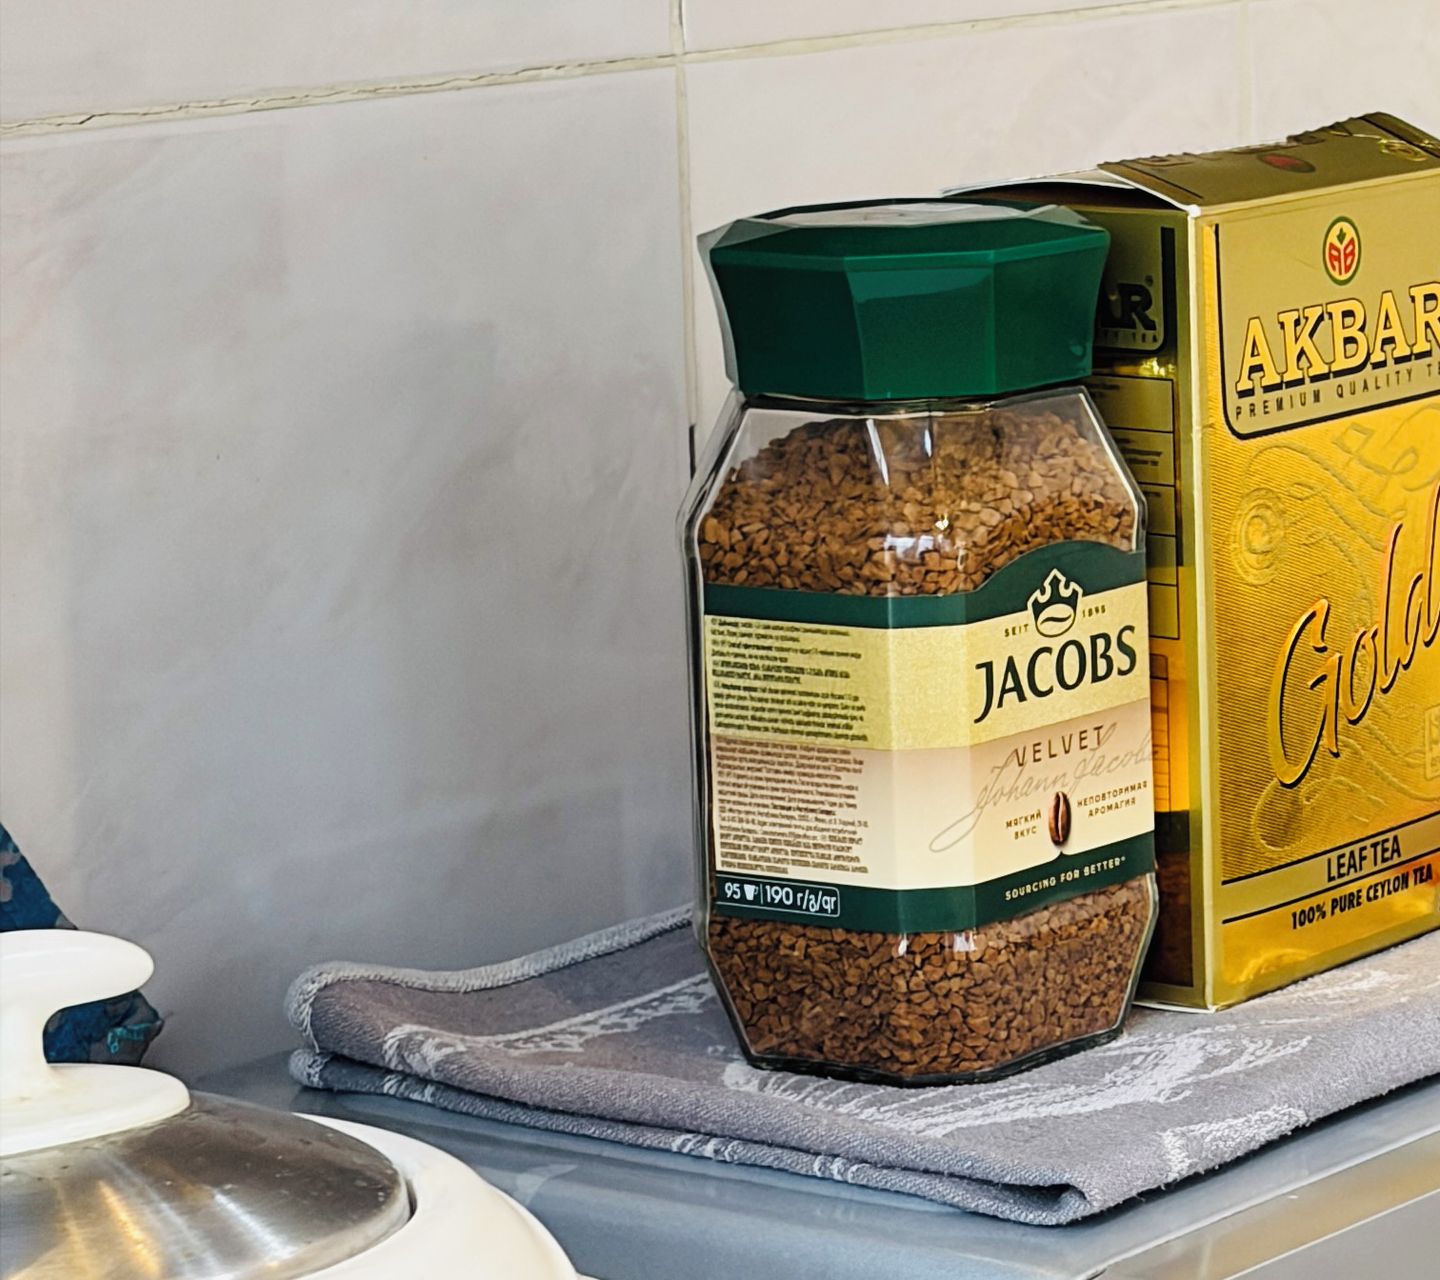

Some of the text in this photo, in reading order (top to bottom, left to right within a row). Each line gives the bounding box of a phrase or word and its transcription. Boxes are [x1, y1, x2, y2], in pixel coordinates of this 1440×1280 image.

[1236, 388, 1321, 420] PREMIUM
[1336, 368, 1413, 398] QUALITY
[1003, 623, 1029, 638] SEIT
[973, 624, 1137, 724] JACOBS
[1014, 724, 1105, 768] VELVET
[1076, 780, 1149, 808] НЕПОВТОРИМАЯ
[1087, 797, 1137, 819] АРОМАГИЯ
[1005, 808, 1043, 830] МЯГКИЙ
[1013, 825, 1038, 841] ВКУС
[1326, 834, 1402, 883] LEAF TEA
[724, 881, 741, 900] 95
[765, 884, 794, 906] 190
[1004, 875, 1057, 901] SOURCING
[1060, 867, 1080, 883] FOR
[1291, 863, 1433, 930] 100% PURE CEYLON TEA
